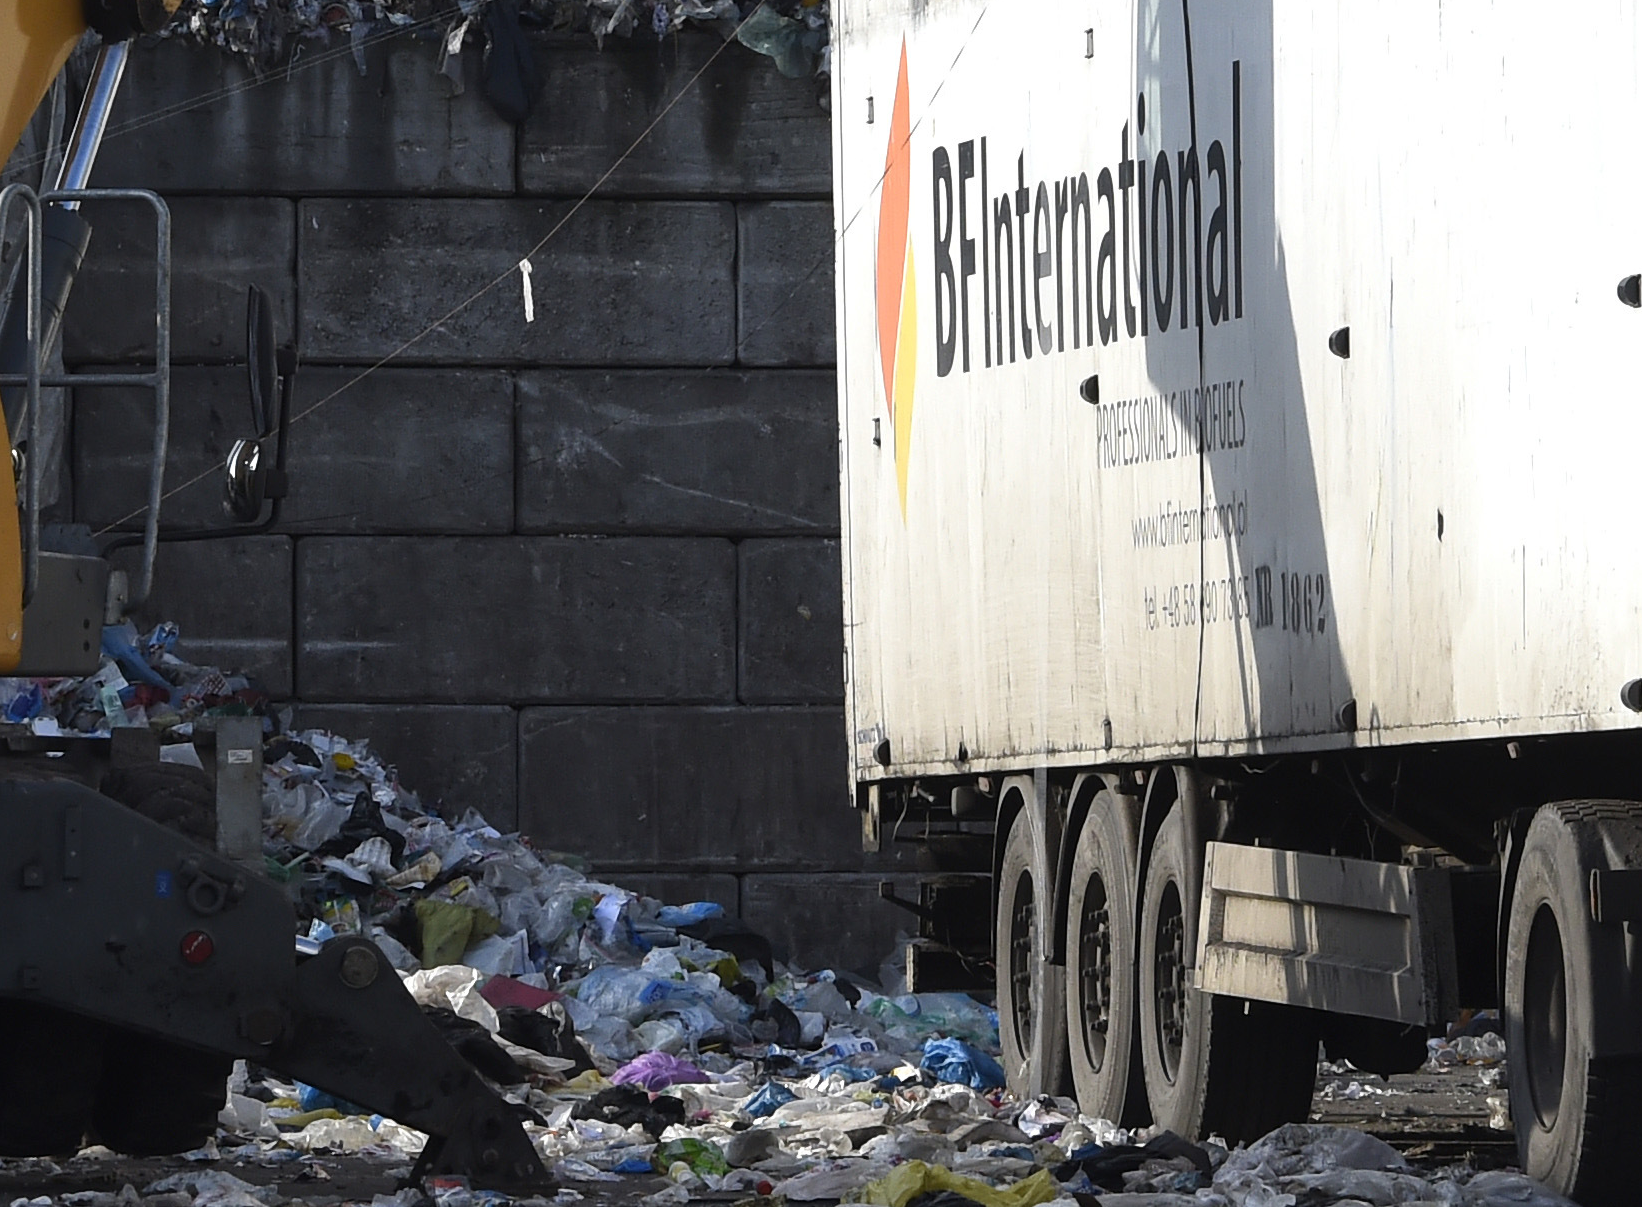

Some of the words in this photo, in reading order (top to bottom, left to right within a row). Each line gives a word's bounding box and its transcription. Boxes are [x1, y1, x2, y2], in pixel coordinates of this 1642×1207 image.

[1096, 391, 1177, 469] PROFESSIONALS
[1181, 389, 1192, 458] IN
[1195, 379, 1245, 455] BOFUELS
[1184, 583, 1196, 626] 58
[1201, 580, 1217, 624] 90
[1281, 571, 1325, 636] 1862
